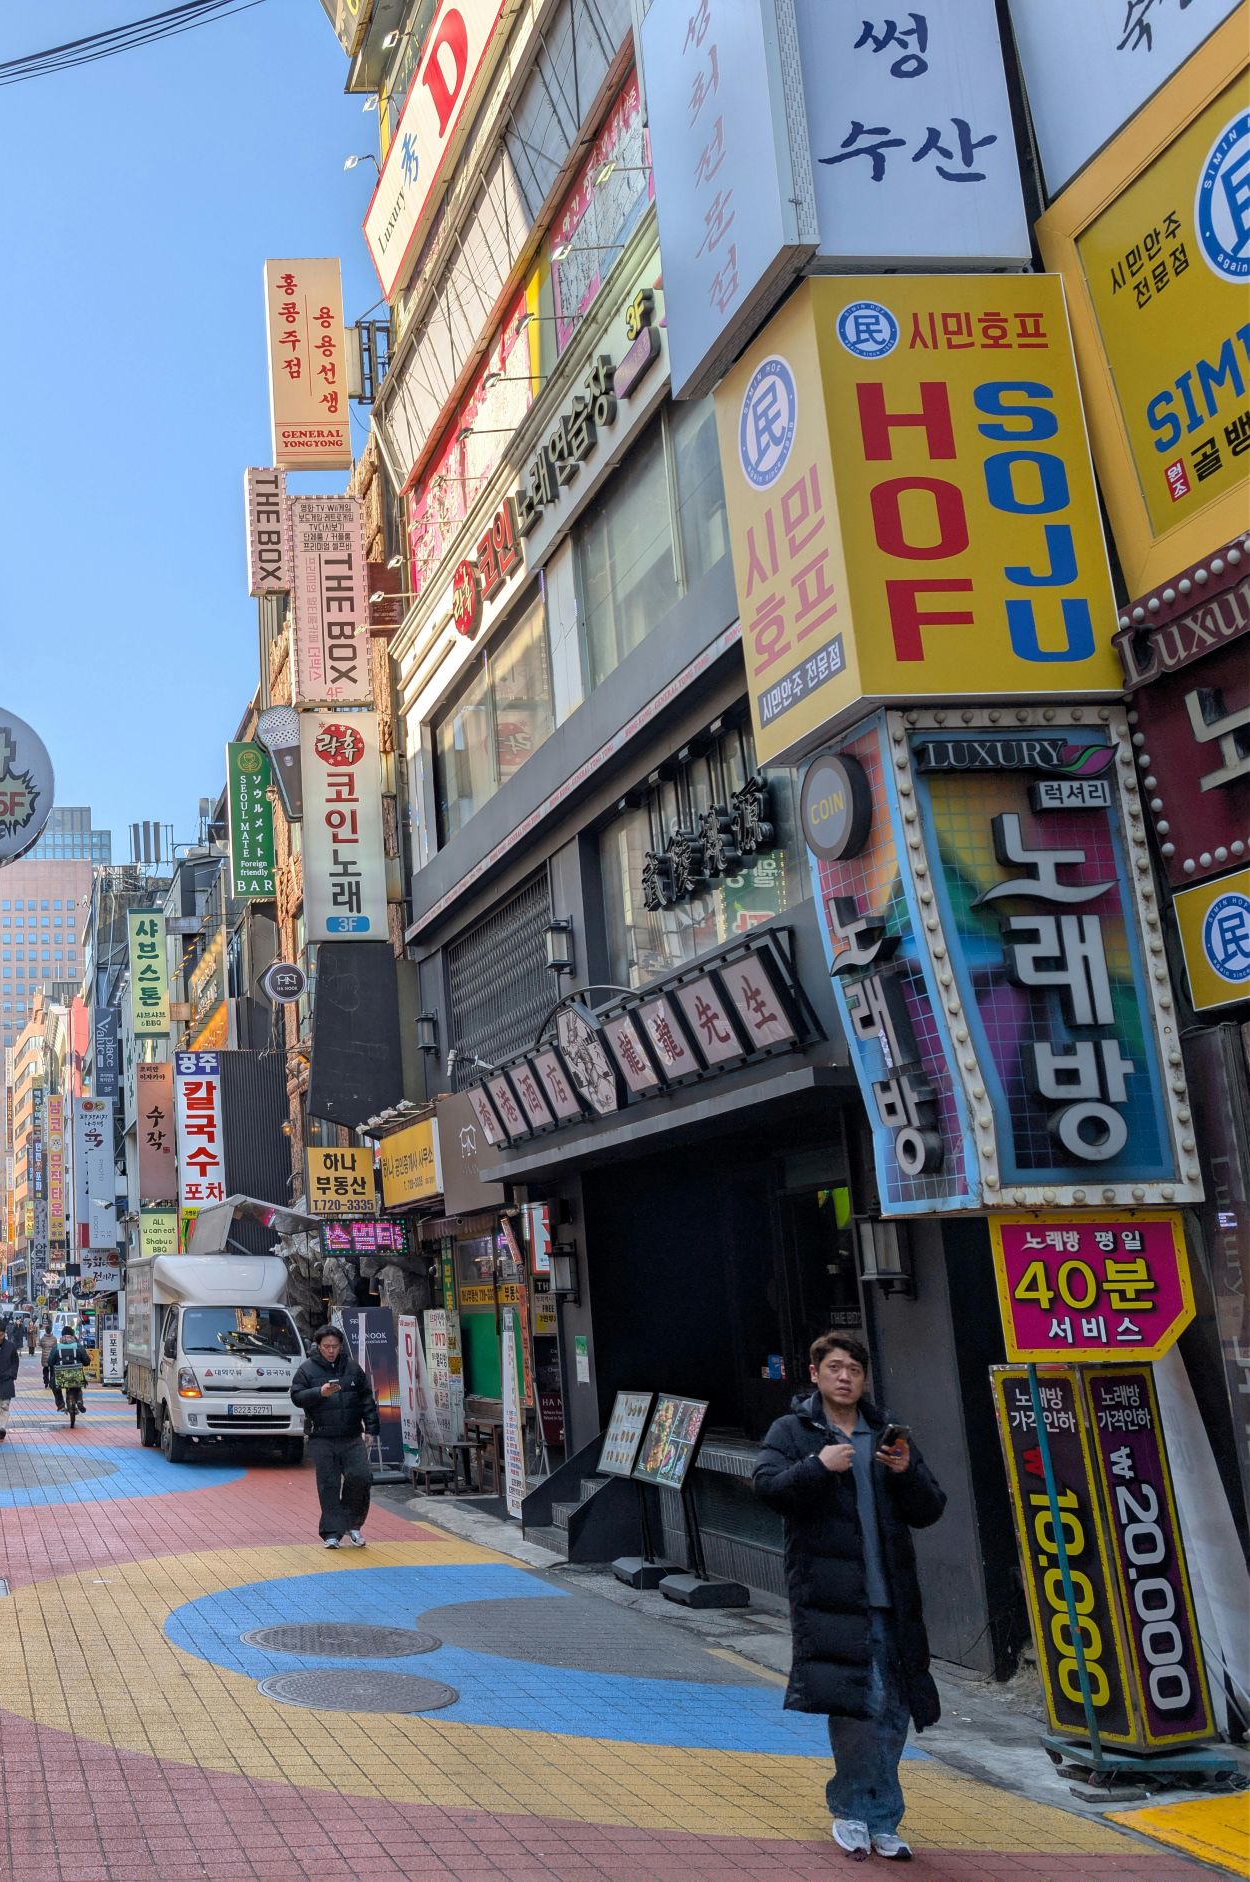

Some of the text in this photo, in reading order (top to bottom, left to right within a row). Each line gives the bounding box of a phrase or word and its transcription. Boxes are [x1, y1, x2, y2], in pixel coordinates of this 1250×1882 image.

[817, 118, 997, 183] 수산
[1204, 130, 1237, 189] SIMIN
[377, 186, 406, 255] Luxury
[1109, 210, 1182, 296] 시민안주
[1132, 243, 1191, 310] 전문점
[276, 274, 301, 379] 홍콩주점
[852, 315, 887, 345] 民
[910, 313, 1049, 350] 시민호프
[313, 306, 338, 413] 용용선생
[282, 430, 343, 438] GENERAL
[752, 380, 786, 469] 民
[1167, 460, 1189, 501] 원조
[300, 504, 314, 512] 영화
[855, 382, 975, 662] HOF
[974, 380, 1096, 662] SOJU
[256, 475, 282, 581] THE BOX
[309, 523, 345, 531] TV다시보기
[331, 533, 351, 541] 커플룸
[746, 463, 825, 597] 시민
[304, 542, 351, 551] 프리미엄 셀프바
[324, 553, 358, 685] THE BOX
[750, 547, 838, 678] 호프
[326, 687, 342, 697] 4F
[762, 642, 842, 722] 시민안주 전문점
[316, 730, 358, 763] 락휴
[926, 741, 1064, 768] LUXURY
[811, 791, 845, 826] COIN
[1044, 781, 1109, 804] 럭셔리
[253, 775, 264, 857] ソウルメイト
[241, 823, 249, 857] MATE
[241, 860, 267, 868] Foreign
[238, 881, 273, 891] BAR
[338, 918, 358, 931] 3F
[136, 919, 162, 1007] 샤브스톤
[971, 812, 1135, 1161] 노래방
[617, 975, 778, 1076] 龍龍先生
[829, 896, 930, 1176] 노래방
[140, 1073, 166, 1081] 이자카야
[179, 1054, 218, 1073] 공주
[146, 1106, 166, 1151] 수작
[183, 1081, 220, 1177] 칼국수
[323, 1153, 356, 1172] 하나
[383, 1148, 433, 1179] 하나 공인중개사 사무소
[185, 1182, 224, 1201] 포차
[317, 1177, 366, 1195] 부동산
[313, 1199, 373, 1211] T.720-3335
[1022, 1230, 1142, 1251] 노래방 평일
[1014, 1257, 1155, 1310] 40분
[1049, 1316, 1142, 1344] 서비스
[109, 1339, 118, 1375] 포토부스
[1101, 1385, 1140, 1406] 노래방
[1098, 1408, 1151, 1431] 가격인하
